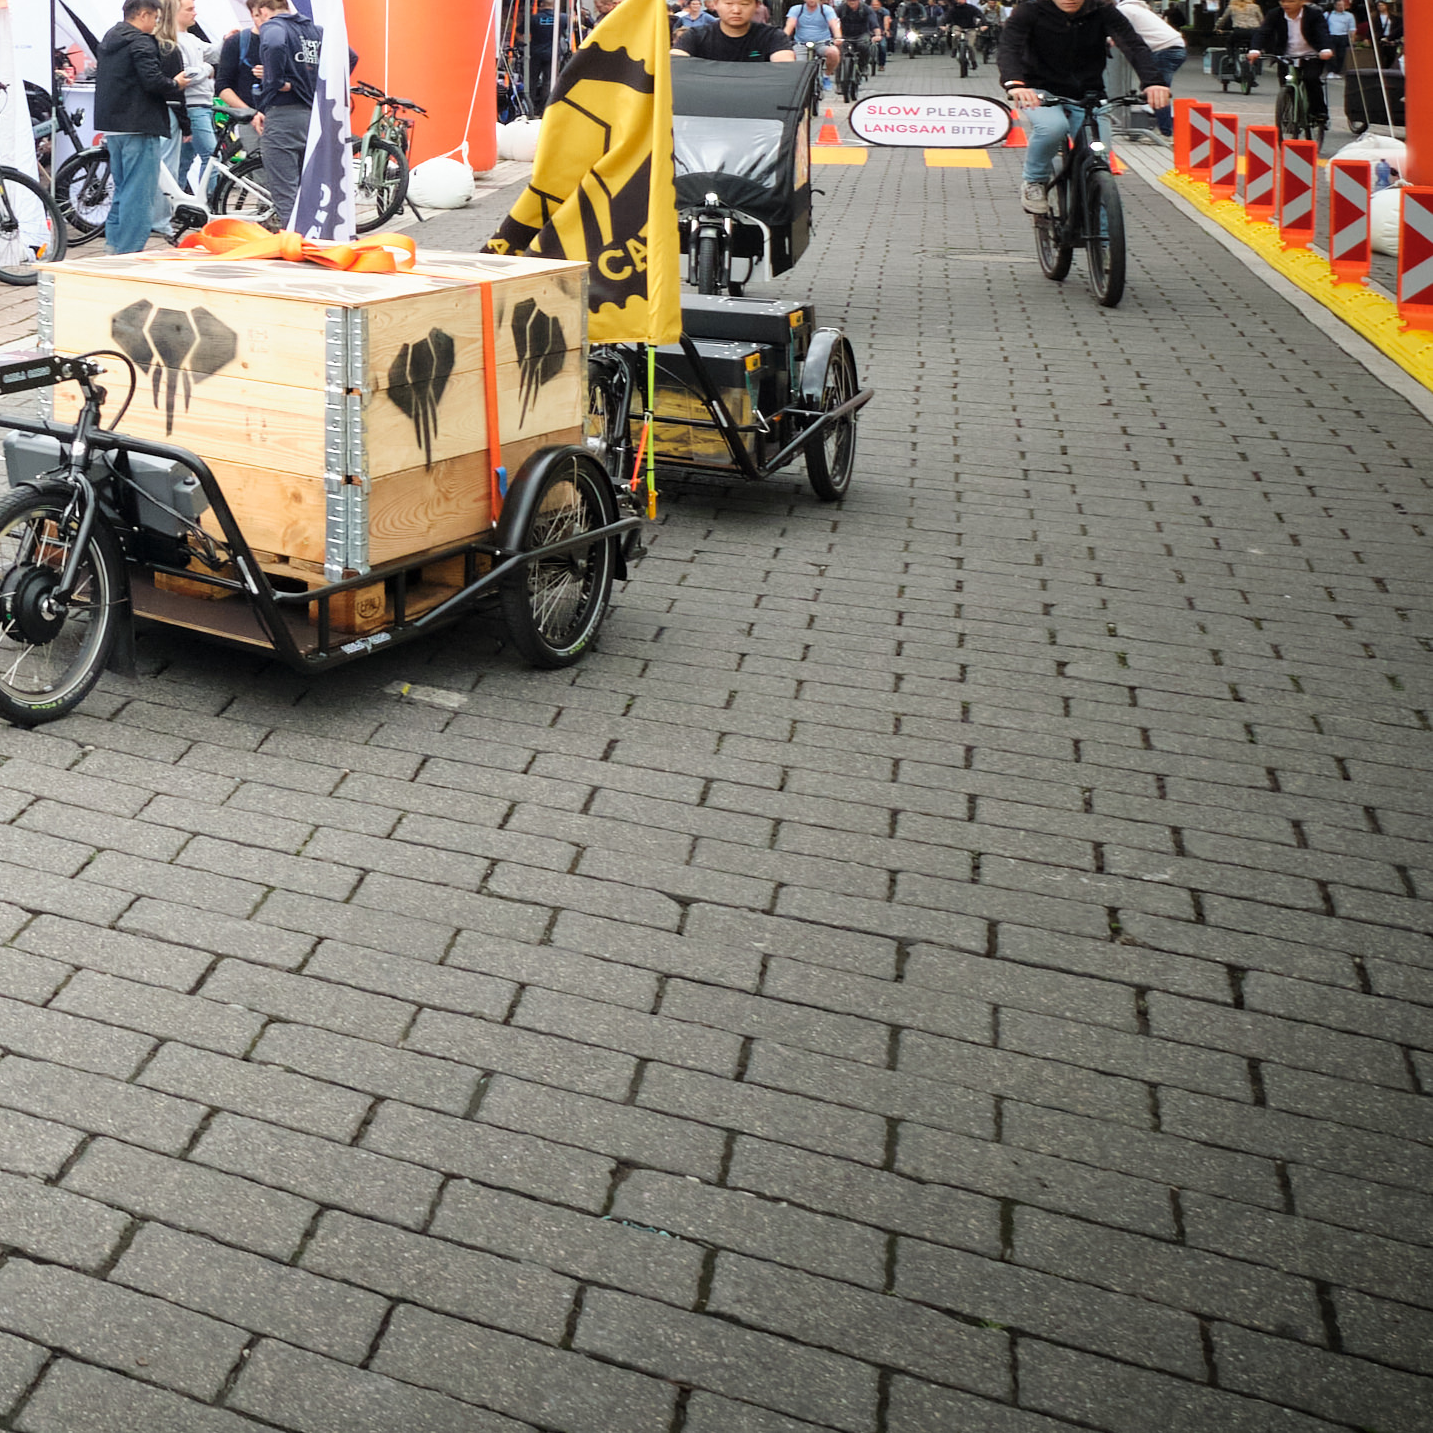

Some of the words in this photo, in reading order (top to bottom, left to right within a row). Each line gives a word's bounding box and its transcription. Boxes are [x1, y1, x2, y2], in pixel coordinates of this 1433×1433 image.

[866, 105, 921, 116] SLOW
[926, 106, 993, 118] PLEASE
[864, 123, 946, 134] LANGSAM
[951, 125, 996, 136] BITTE
